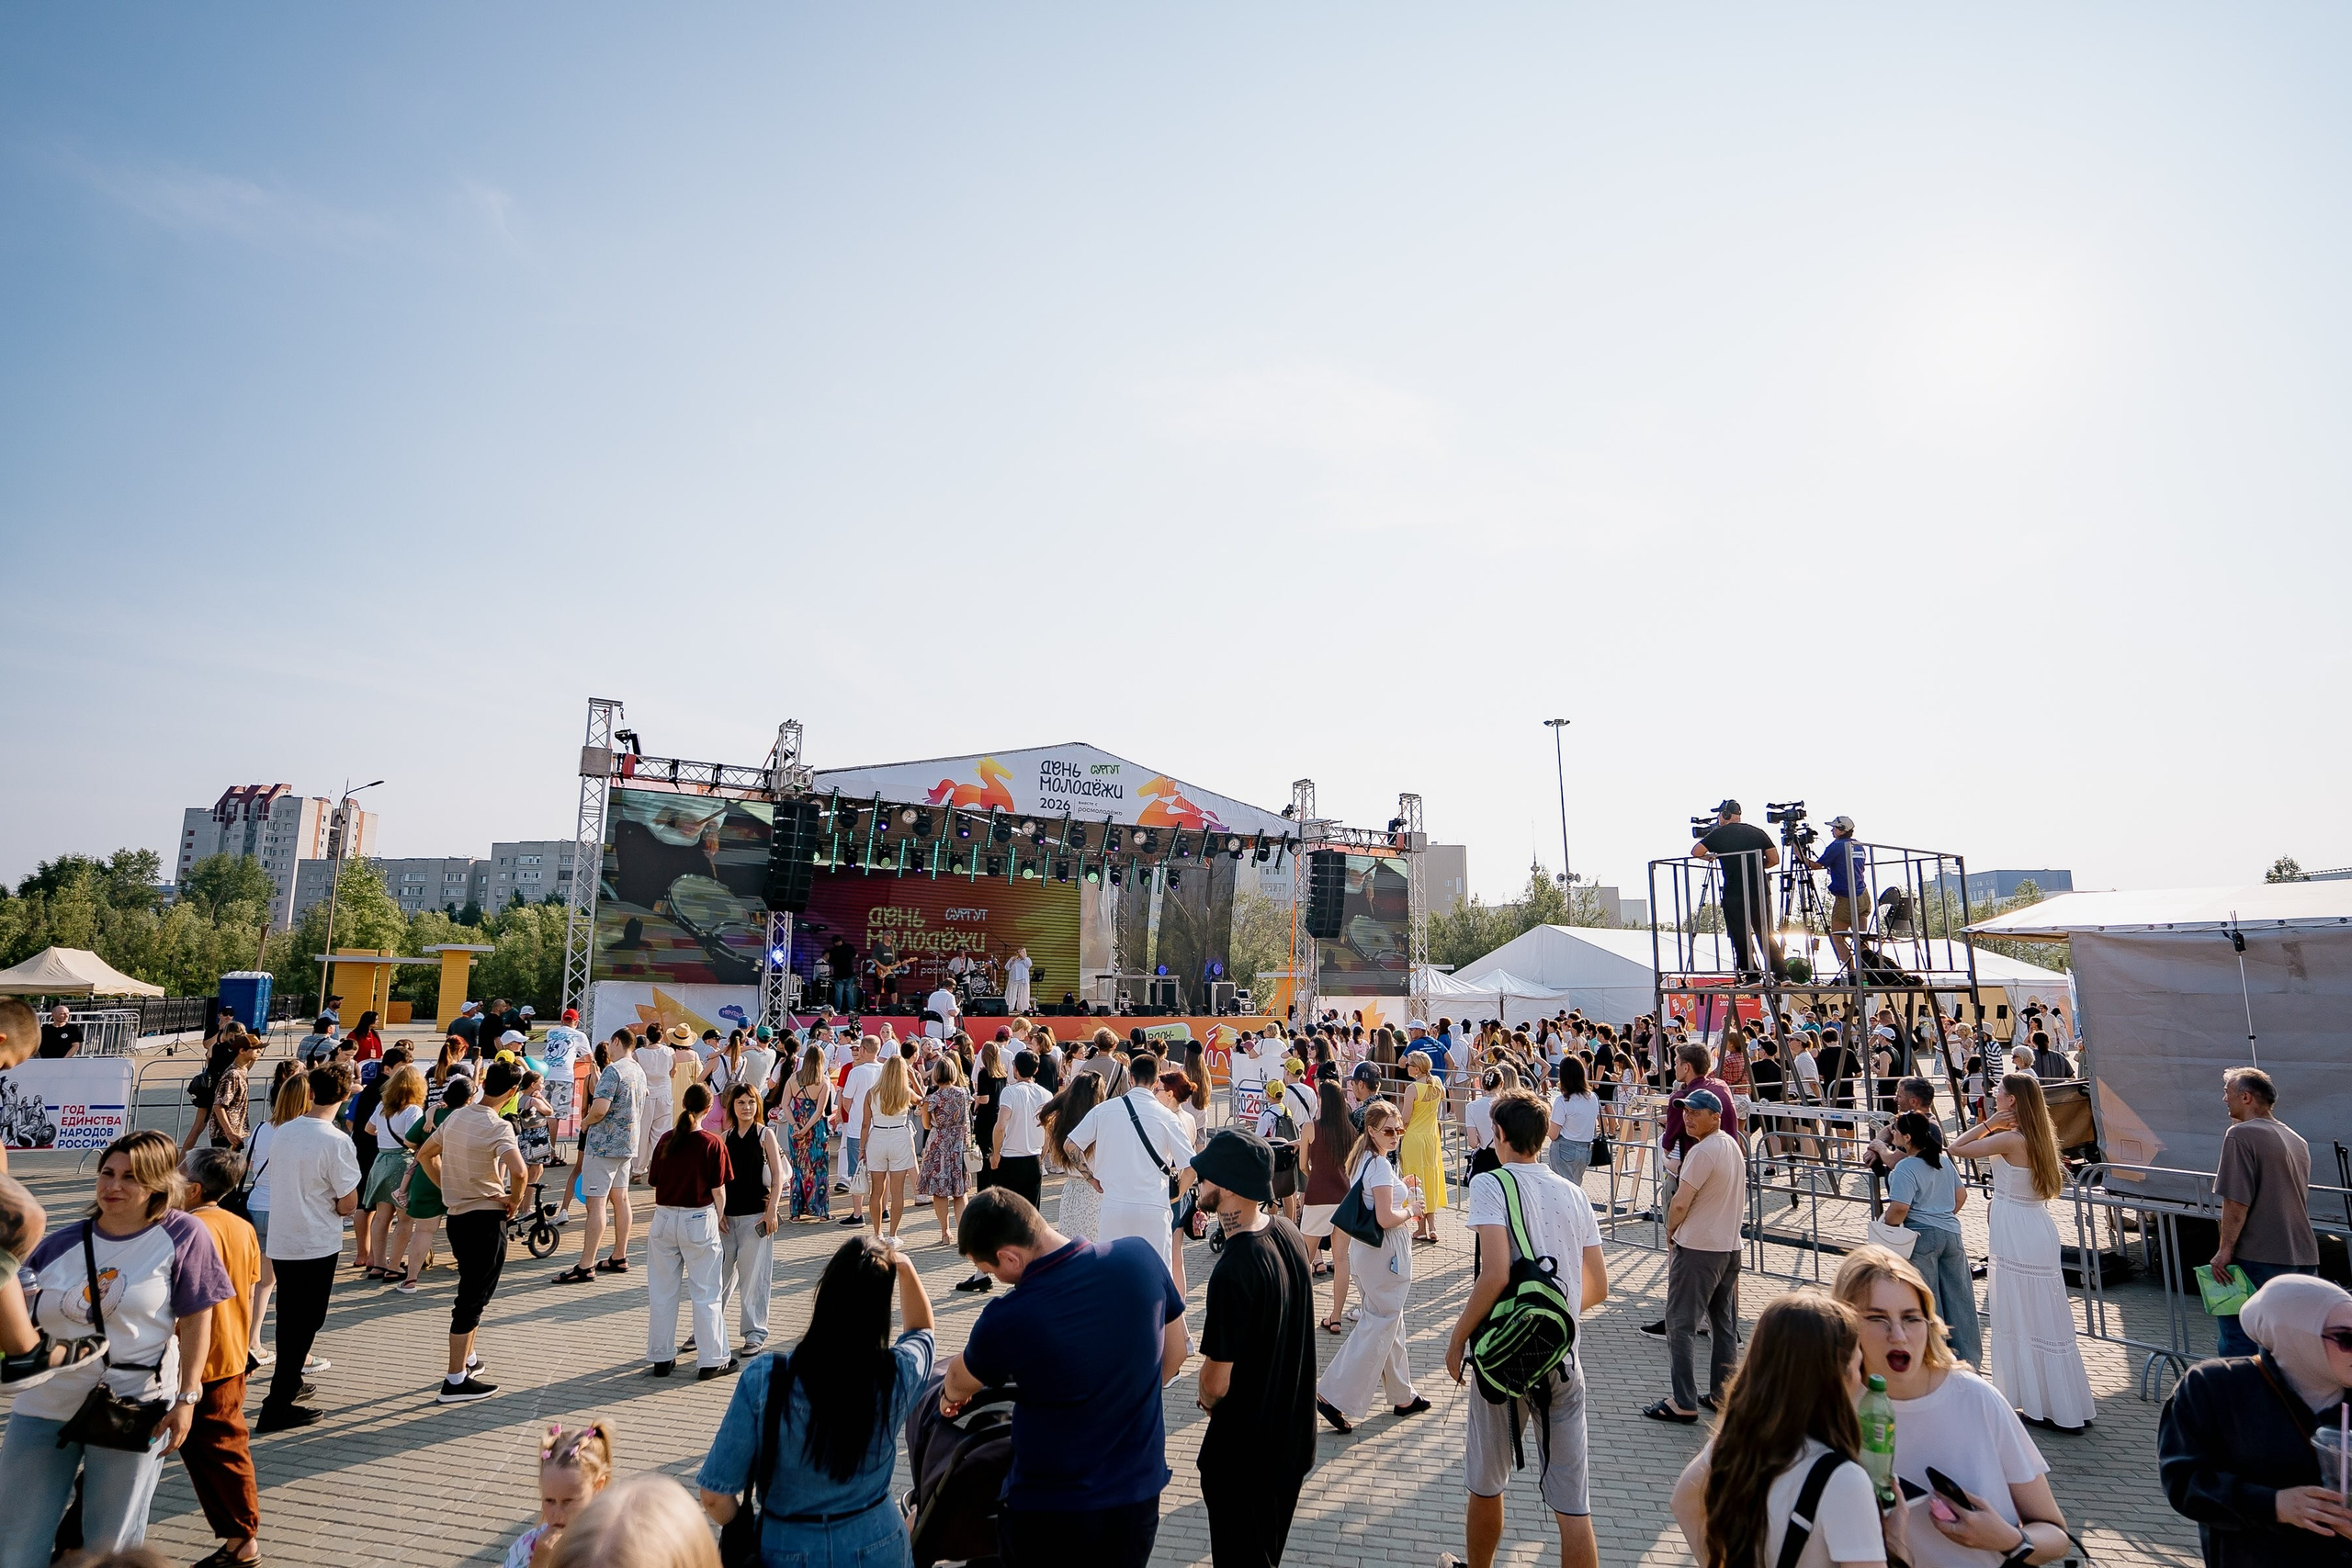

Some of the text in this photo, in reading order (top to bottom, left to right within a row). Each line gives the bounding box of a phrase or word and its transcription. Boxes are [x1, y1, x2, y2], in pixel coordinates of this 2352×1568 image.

[1091, 764, 1120, 774] СУРГУТ
[1040, 775, 1123, 799] МОЛОДЁЖИ
[1040, 797, 1070, 811] 2026
[867, 907, 925, 928] ДЕНЬ
[945, 908, 988, 921] СУРГУТ
[62, 1105, 85, 1115] ГОД
[61, 1116, 121, 1127] ЕДИНСТВА
[59, 1127, 114, 1138] НАРОДОВ
[57, 1138, 107, 1149] РОССИИ
